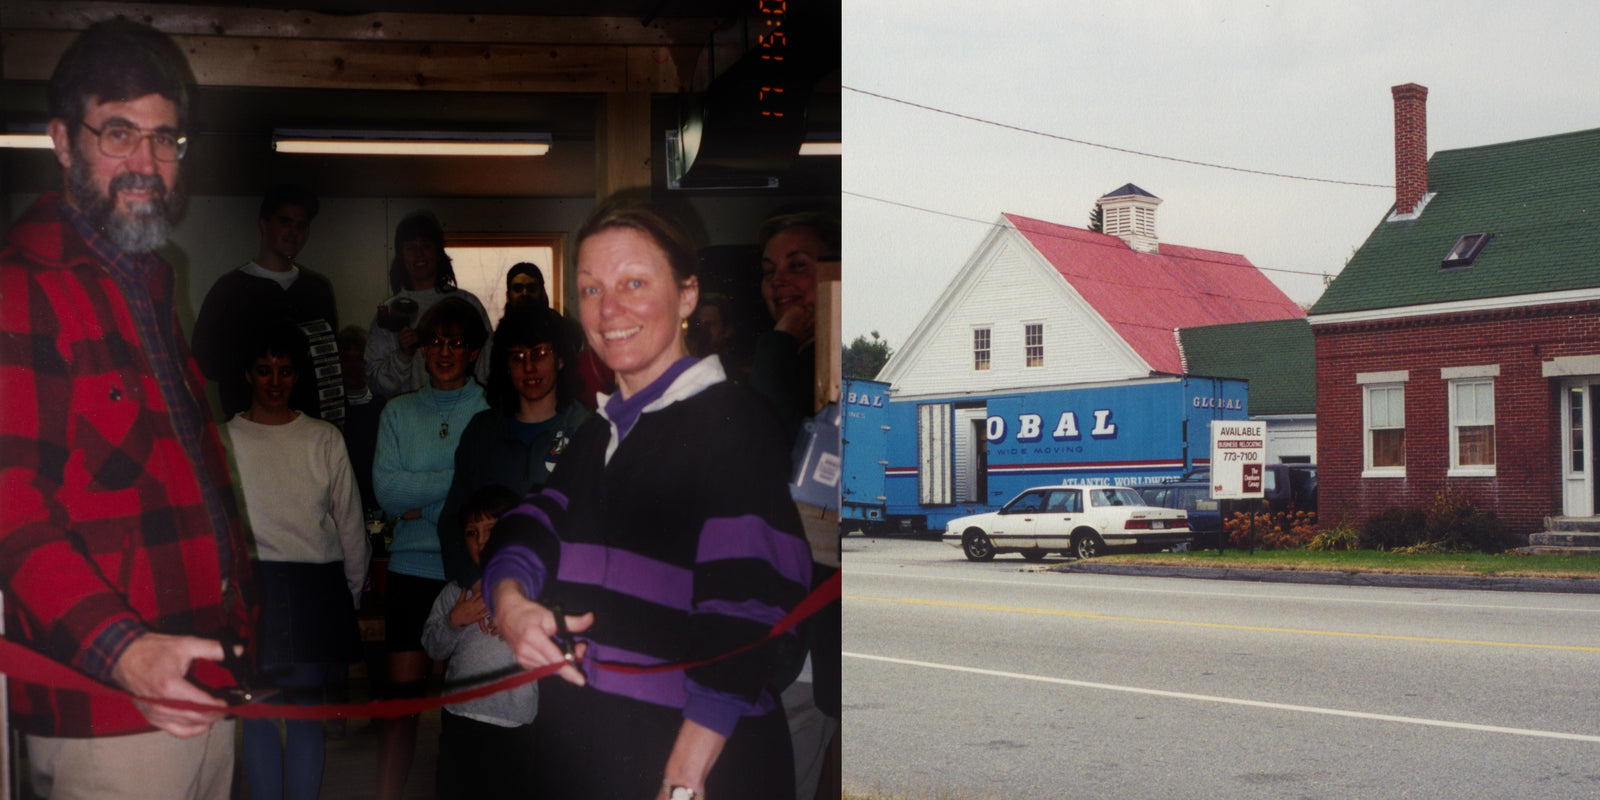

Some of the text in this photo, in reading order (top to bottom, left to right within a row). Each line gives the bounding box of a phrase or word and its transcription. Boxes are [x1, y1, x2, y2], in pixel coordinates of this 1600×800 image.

[1220, 427, 1262, 436] AVAILABLE
[1223, 452, 1258, 461] 773-7100
[1062, 476, 1181, 487] ATLANTIC WORLDWIDE
[1247, 480, 1260, 488] Group
